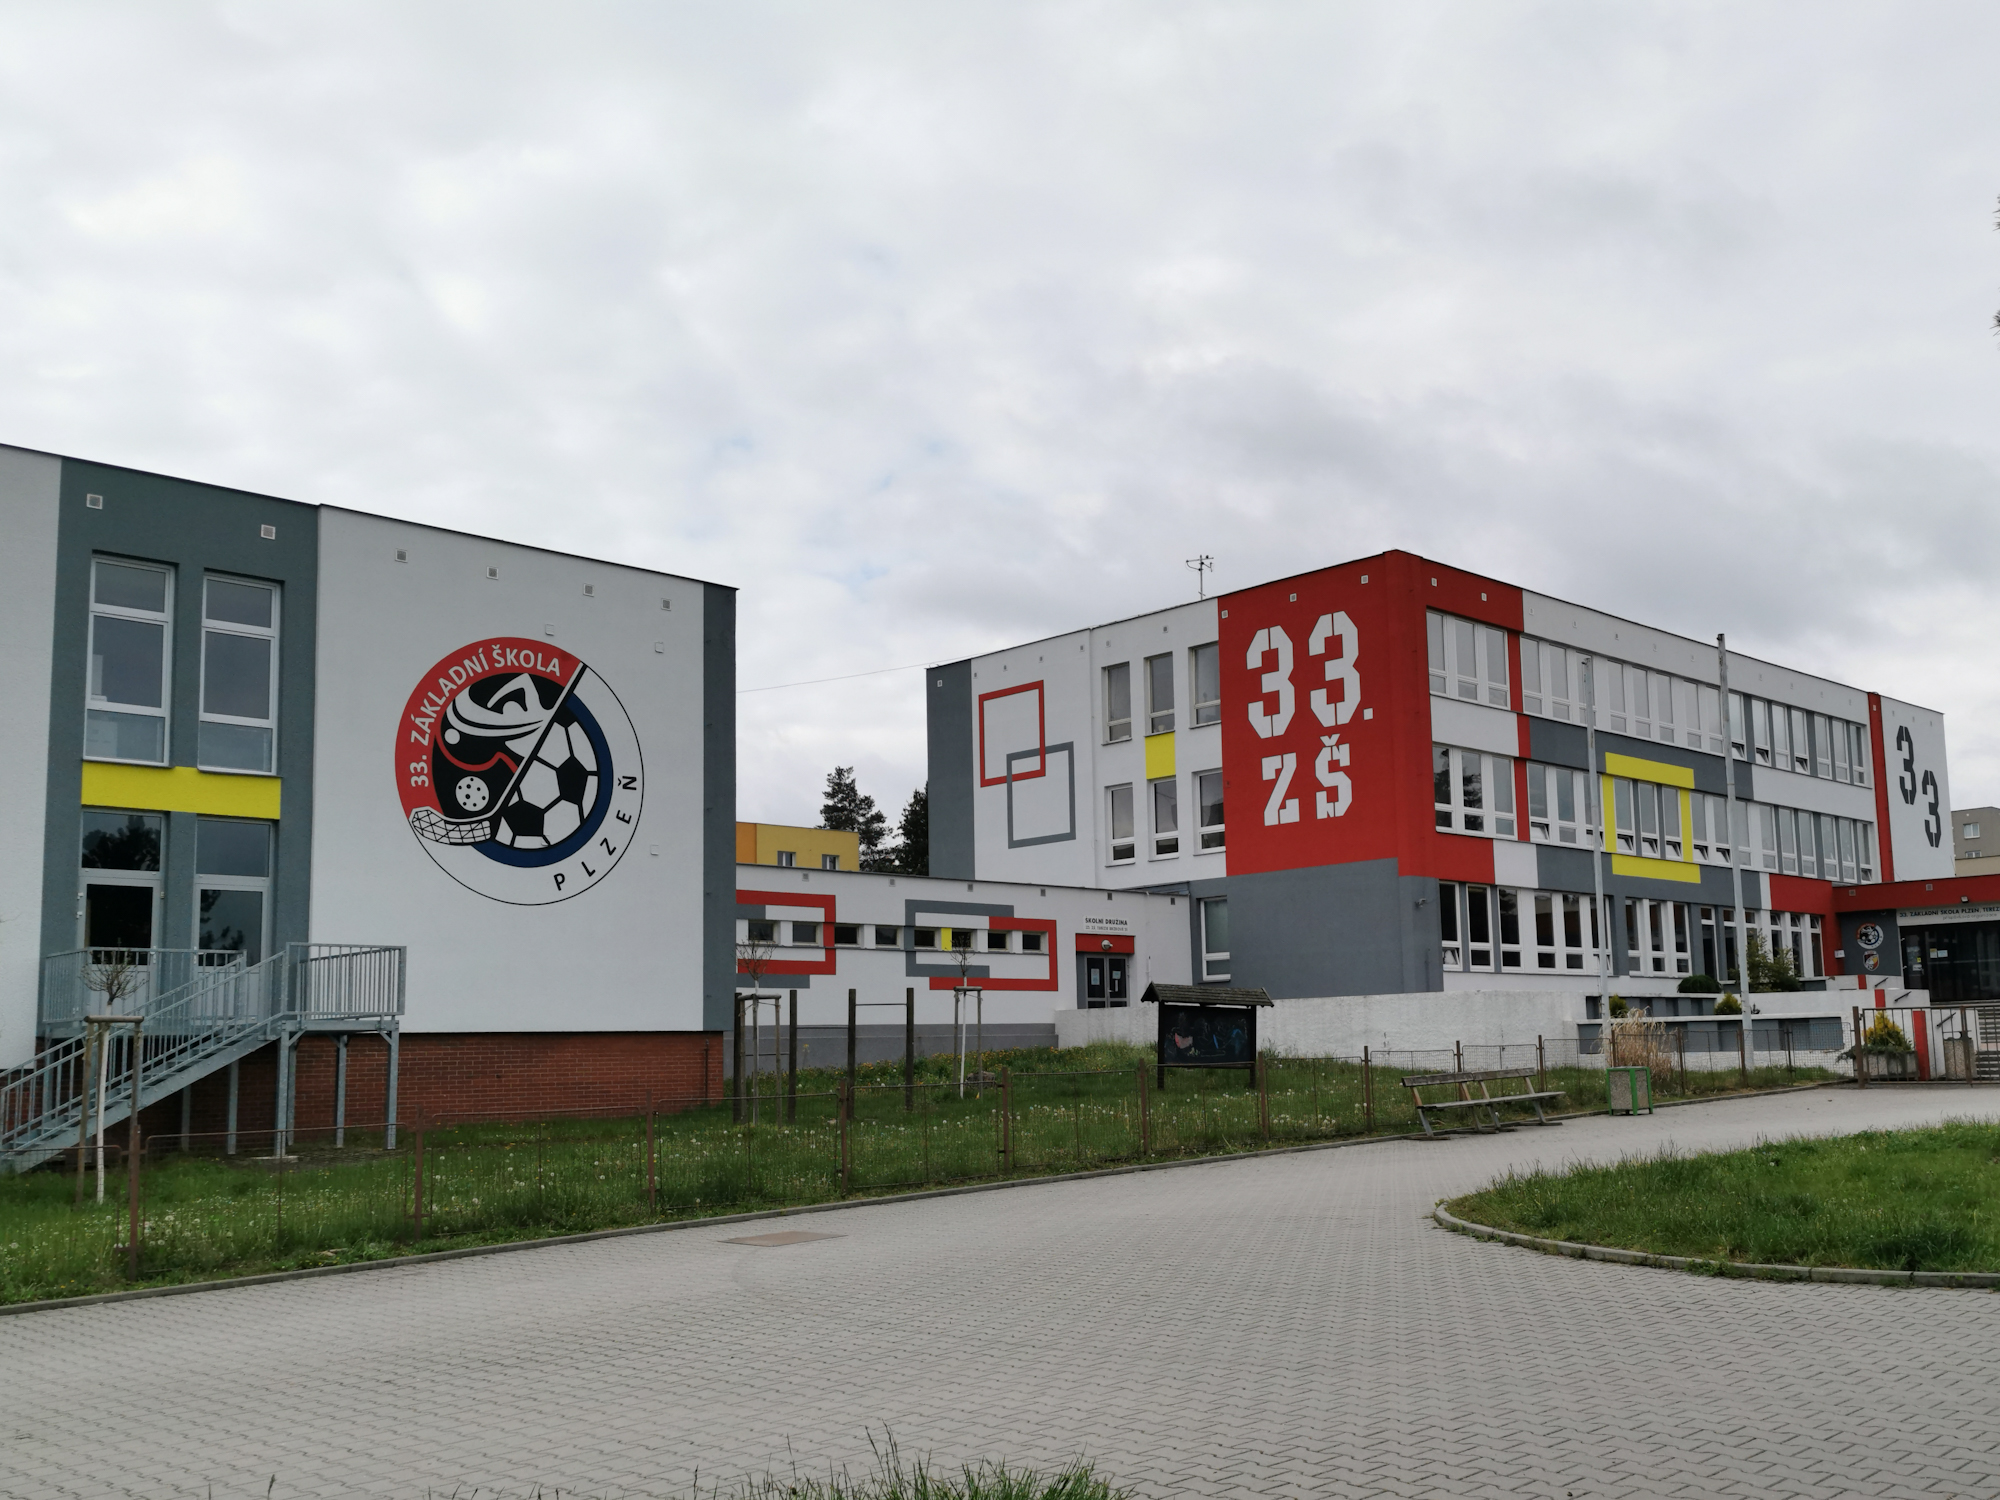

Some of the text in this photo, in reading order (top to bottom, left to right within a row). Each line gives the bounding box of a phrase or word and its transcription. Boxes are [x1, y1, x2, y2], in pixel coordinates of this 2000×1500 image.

[410, 643, 561, 788] 33. ZÁKLADNÍ ŠKOLA
[1246, 610, 1373, 739] 33.
[553, 774, 638, 892] PLZEŇ
[1261, 733, 1353, 827] ZŠ
